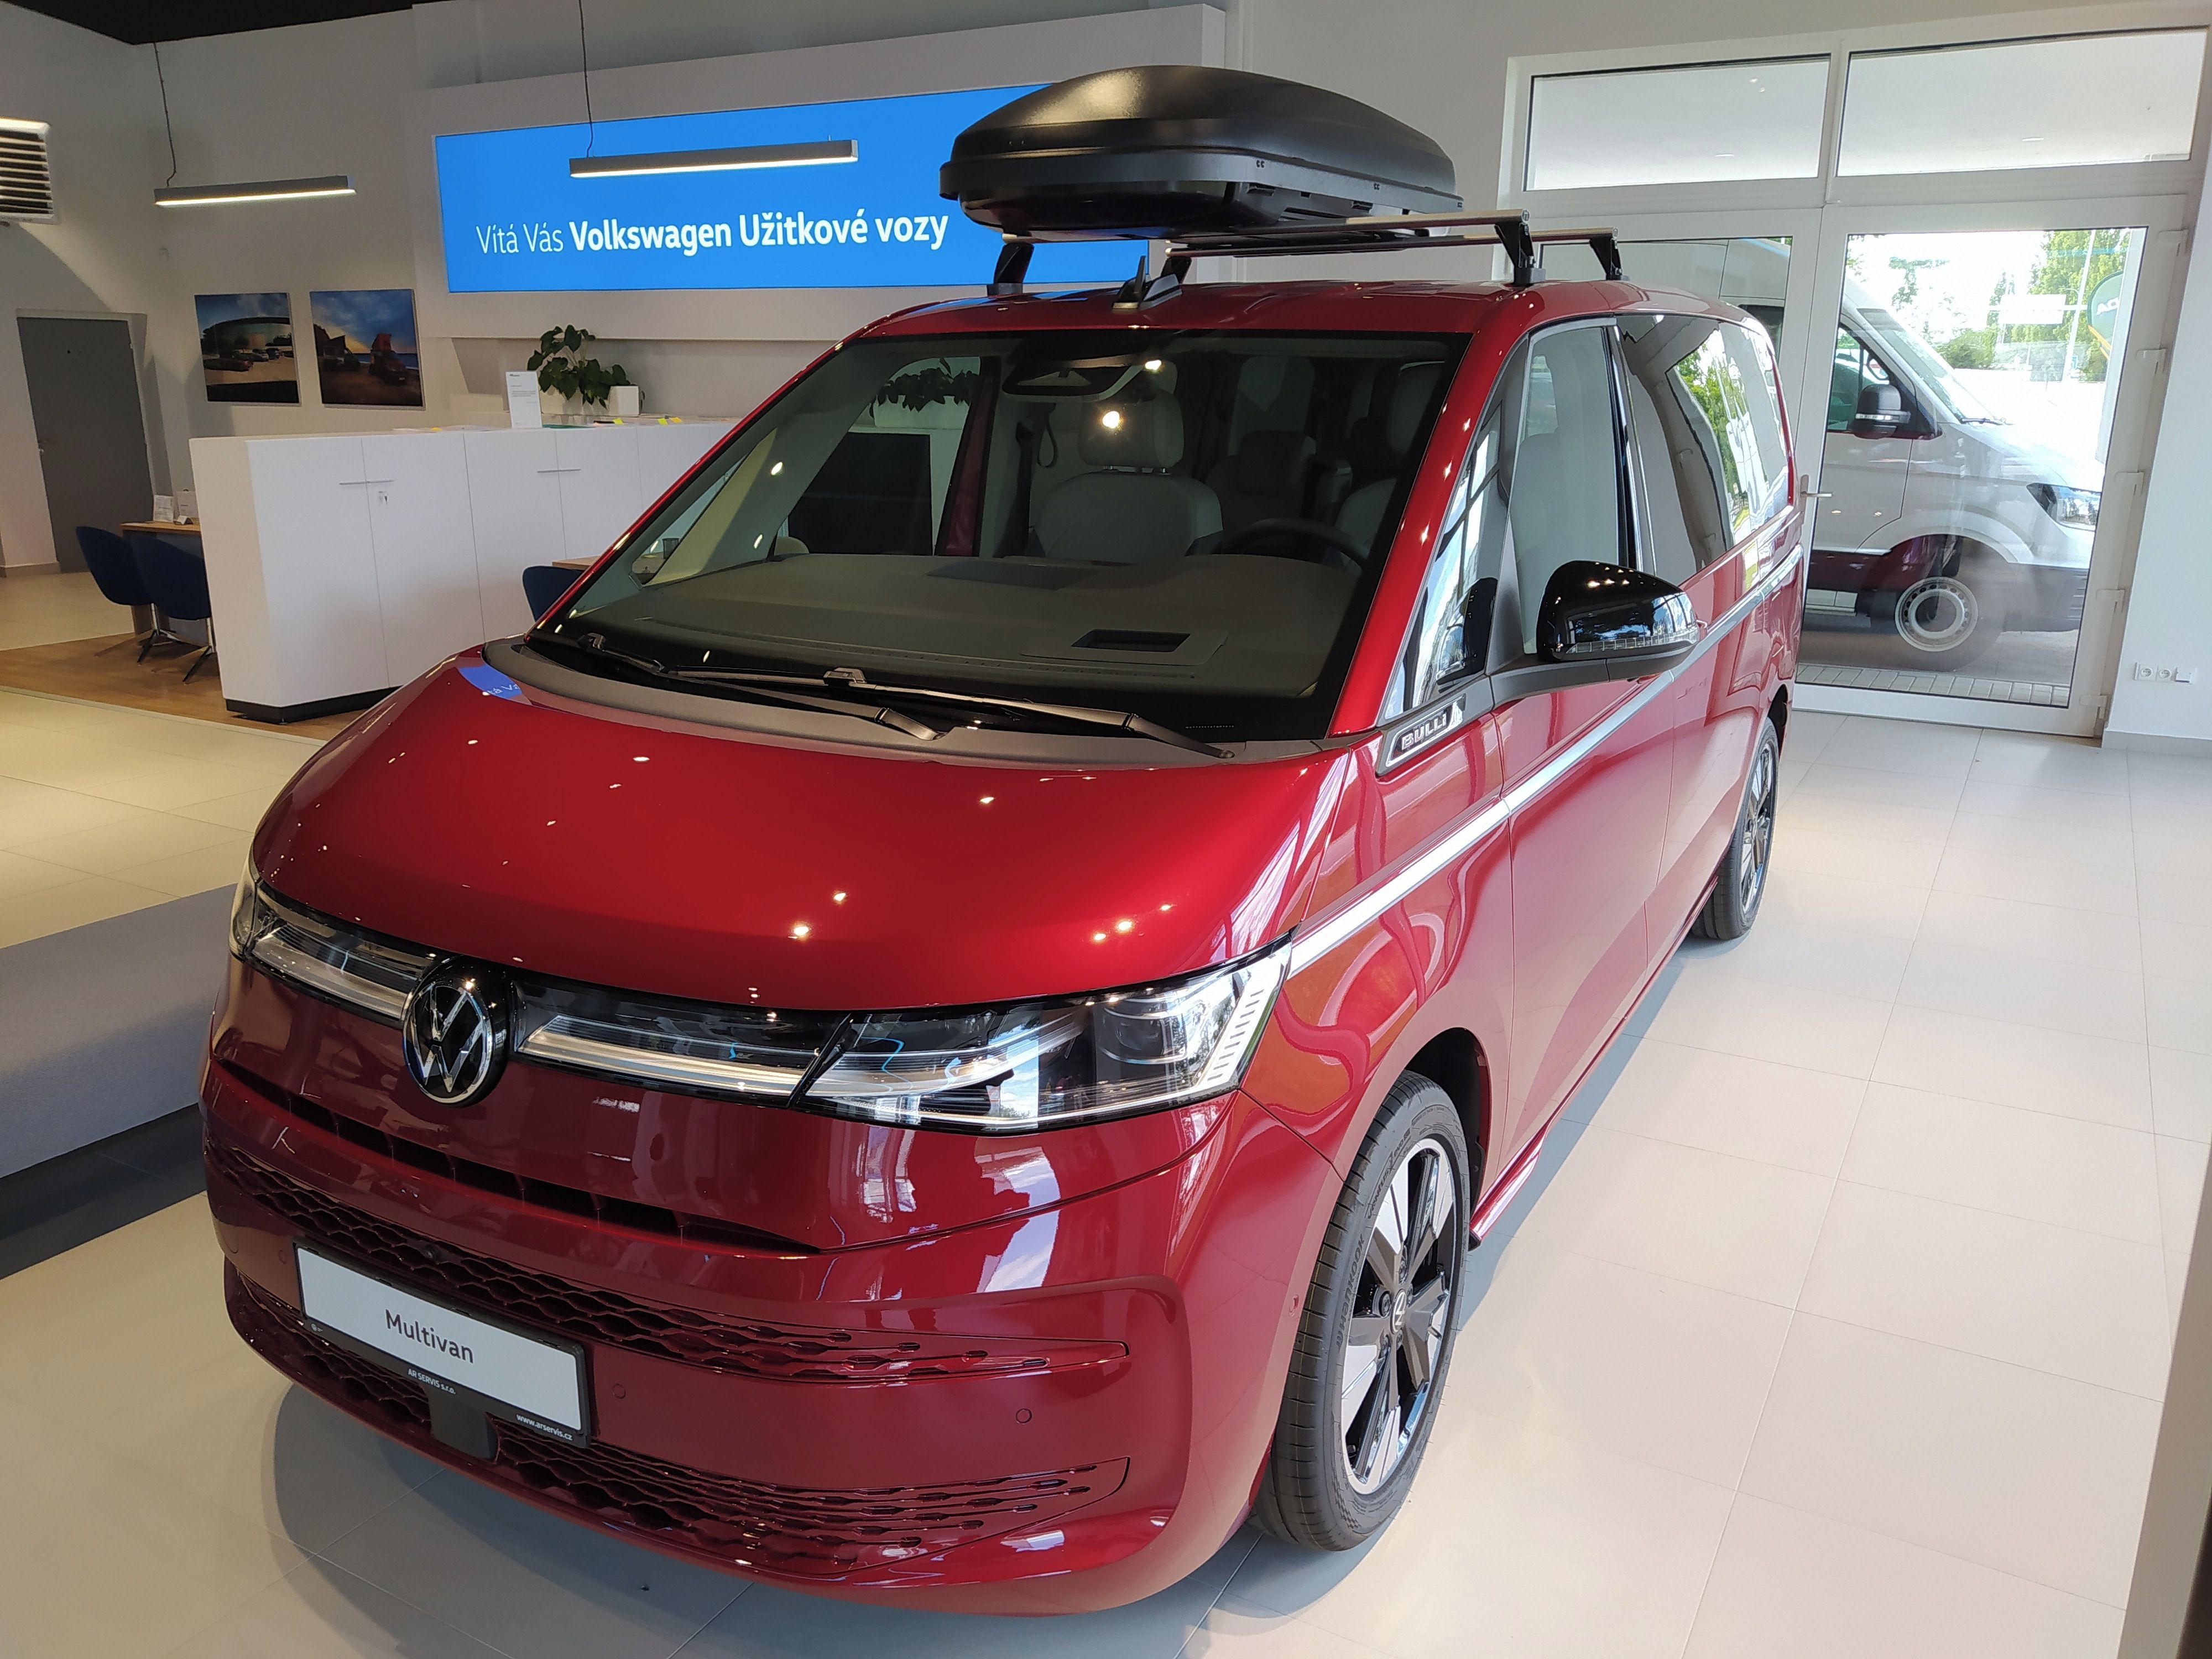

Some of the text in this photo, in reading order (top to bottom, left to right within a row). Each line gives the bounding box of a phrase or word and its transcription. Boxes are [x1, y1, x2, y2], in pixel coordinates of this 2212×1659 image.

[476, 208, 949, 256] Vítá Vás Volkswagen Užitkové vozy
[385, 1308, 473, 1364] Multivan
[408, 1368, 456, 1395] AR SERVIS s.r.o.
[516, 1414, 573, 1441] www.arservis.cz
